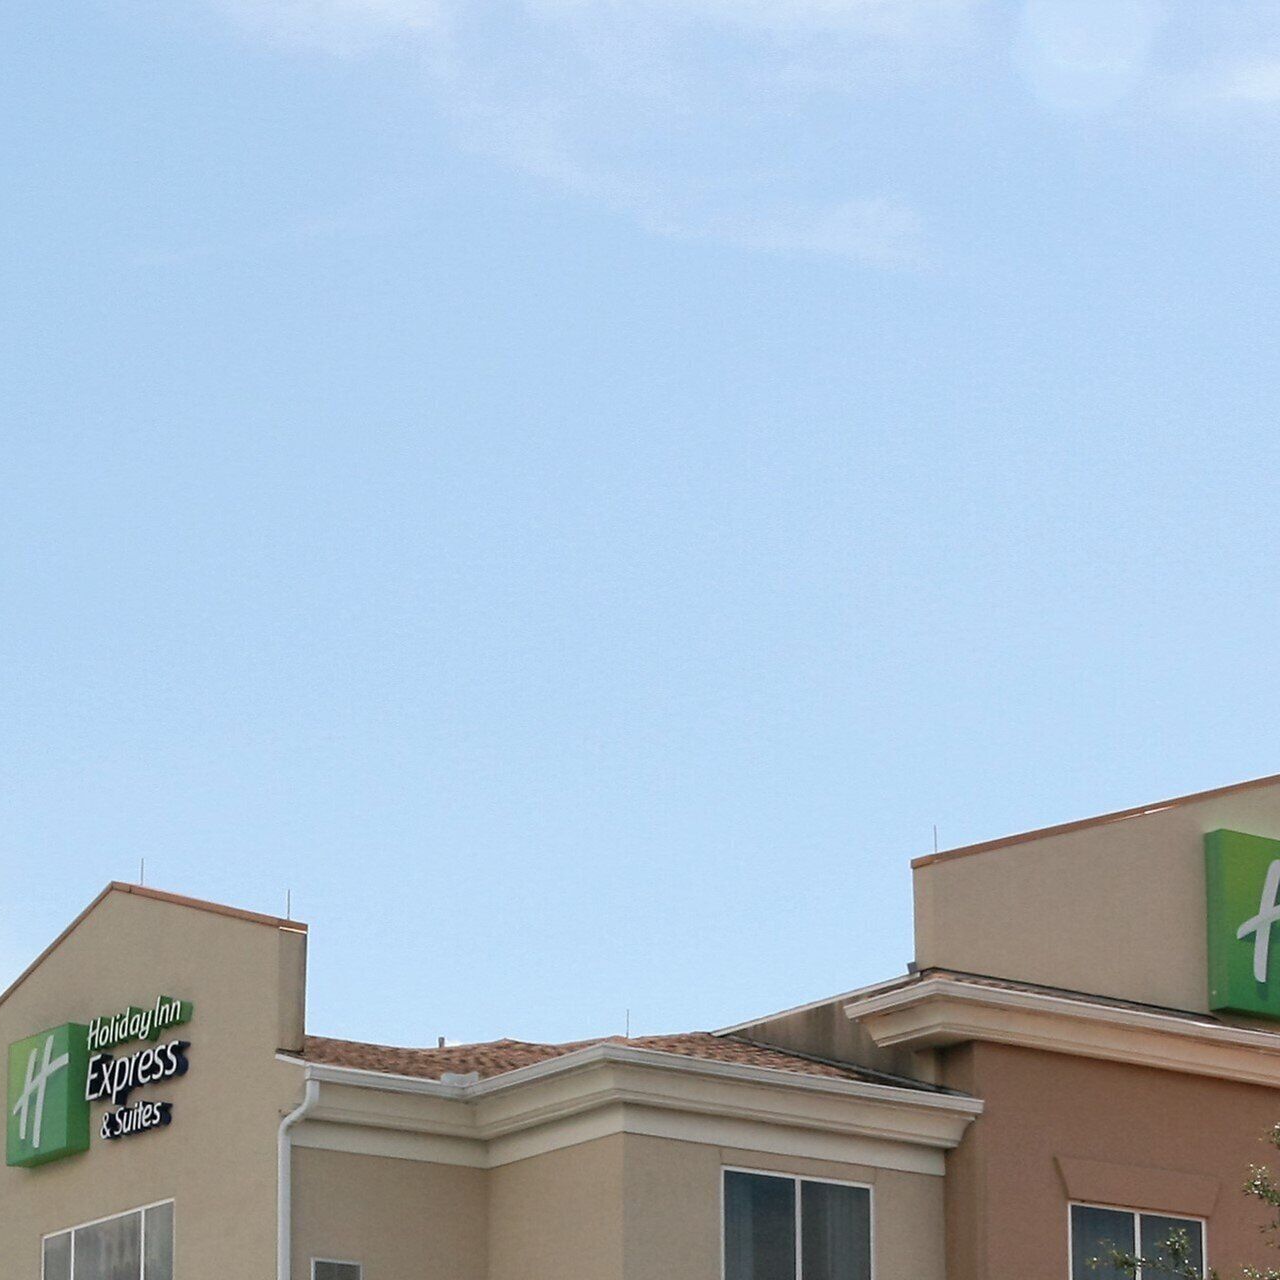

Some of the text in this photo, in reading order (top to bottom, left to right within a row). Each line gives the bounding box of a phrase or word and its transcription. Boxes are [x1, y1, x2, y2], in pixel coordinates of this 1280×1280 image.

[86, 996, 181, 1051] Holiday Inn
[84, 1040, 180, 1104] Express
[99, 1101, 162, 1139] & Suites
